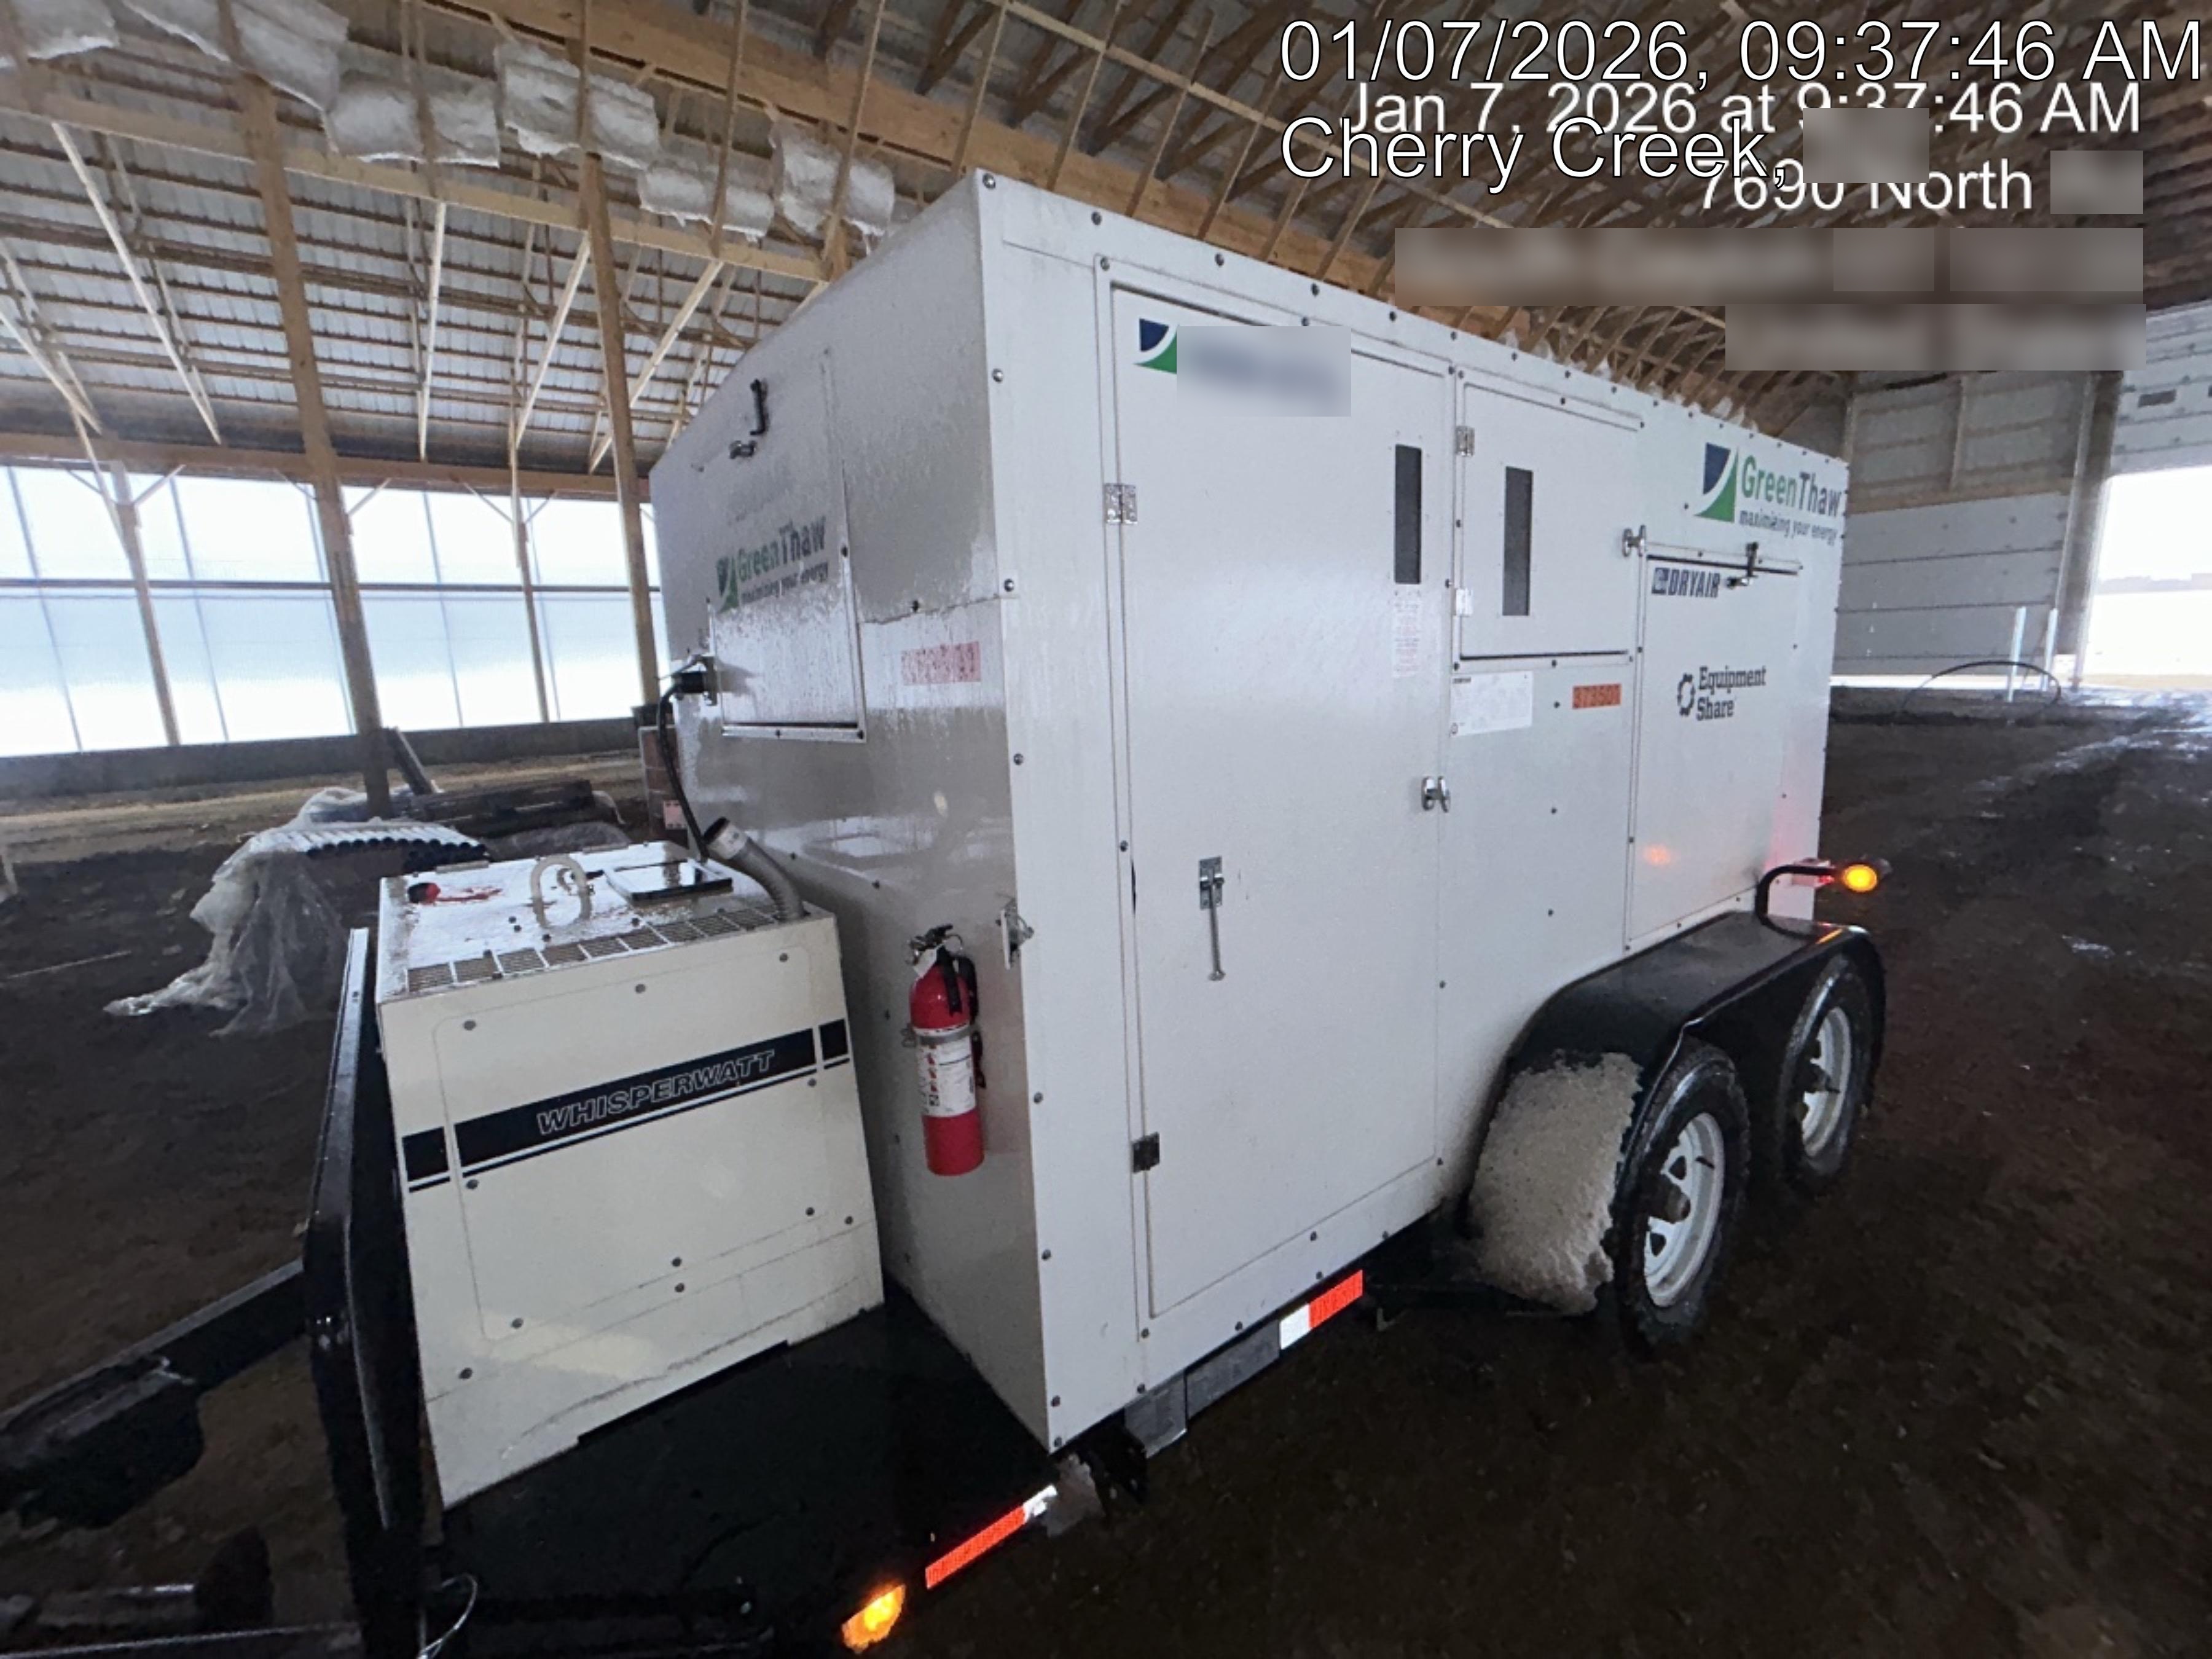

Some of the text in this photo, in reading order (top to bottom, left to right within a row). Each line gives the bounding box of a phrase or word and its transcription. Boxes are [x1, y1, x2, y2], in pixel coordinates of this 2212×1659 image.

[1741, 455, 1842, 517] GreenThaw
[738, 516, 826, 582] GreenThaw
[1668, 568, 1720, 598] DRYAIR
[1699, 665, 1767, 696] Equipment
[1696, 697, 1734, 721] Share
[536, 1048, 775, 1135] WHISPERWATT
